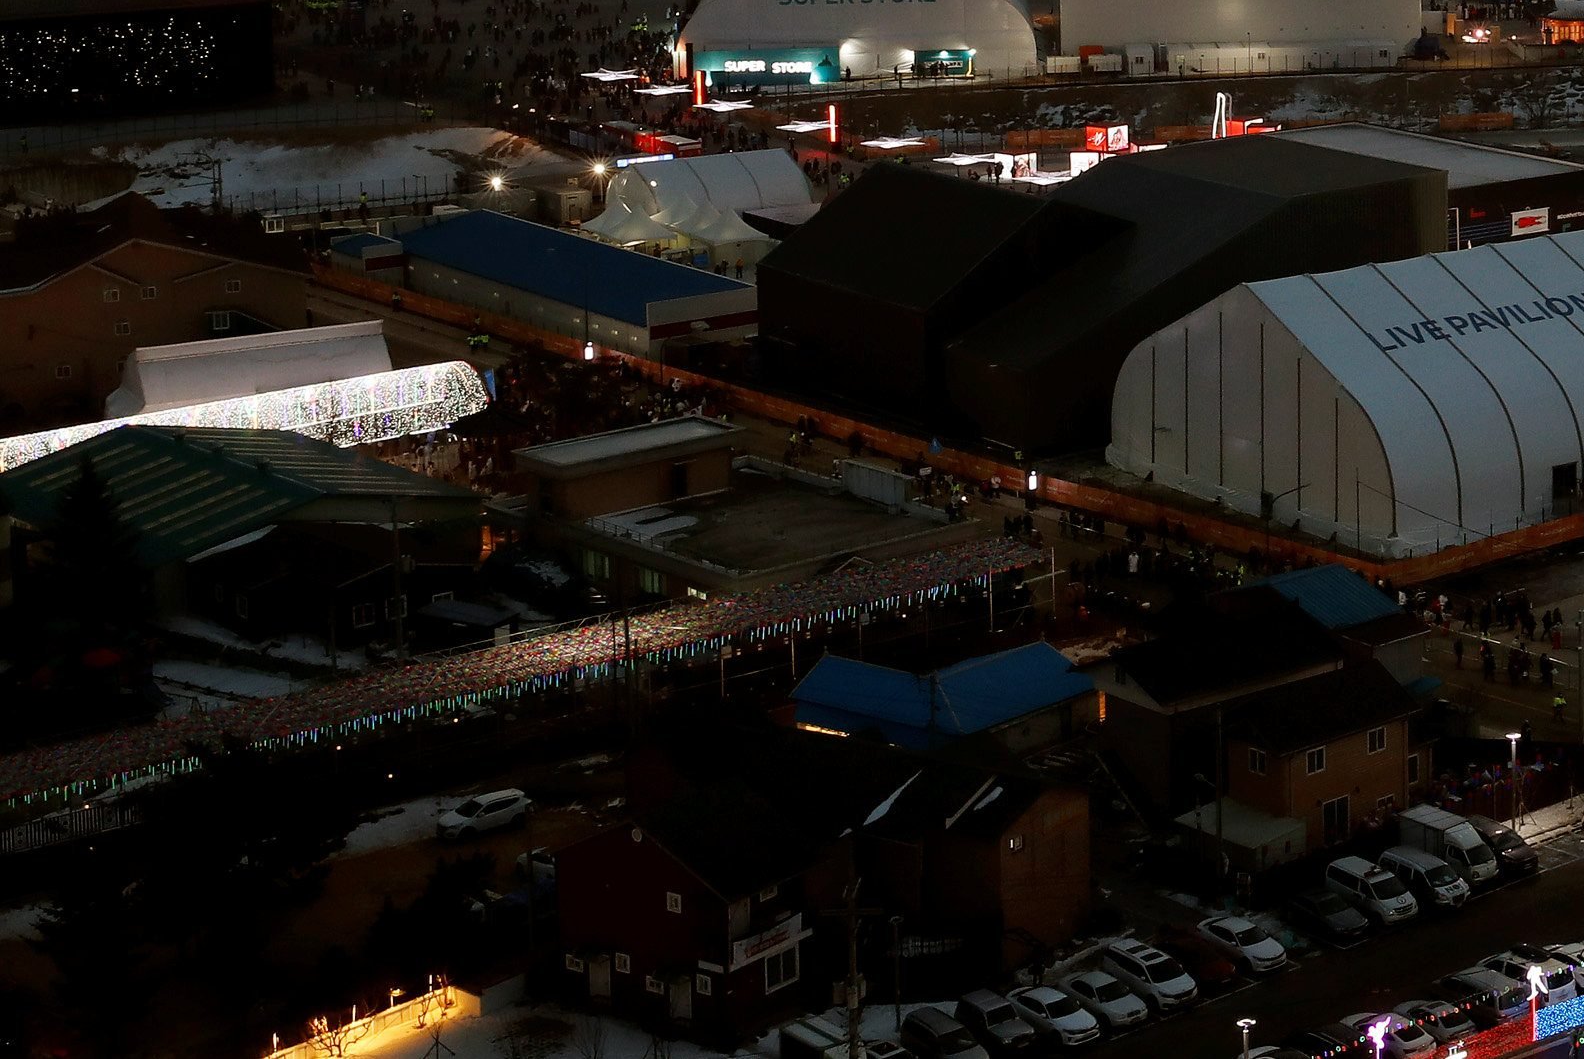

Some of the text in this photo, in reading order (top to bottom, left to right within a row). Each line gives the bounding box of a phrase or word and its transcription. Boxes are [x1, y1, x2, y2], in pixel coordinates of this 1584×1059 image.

[724, 60, 813, 74] SUPER STORE
[1366, 319, 1452, 353] LIVE
